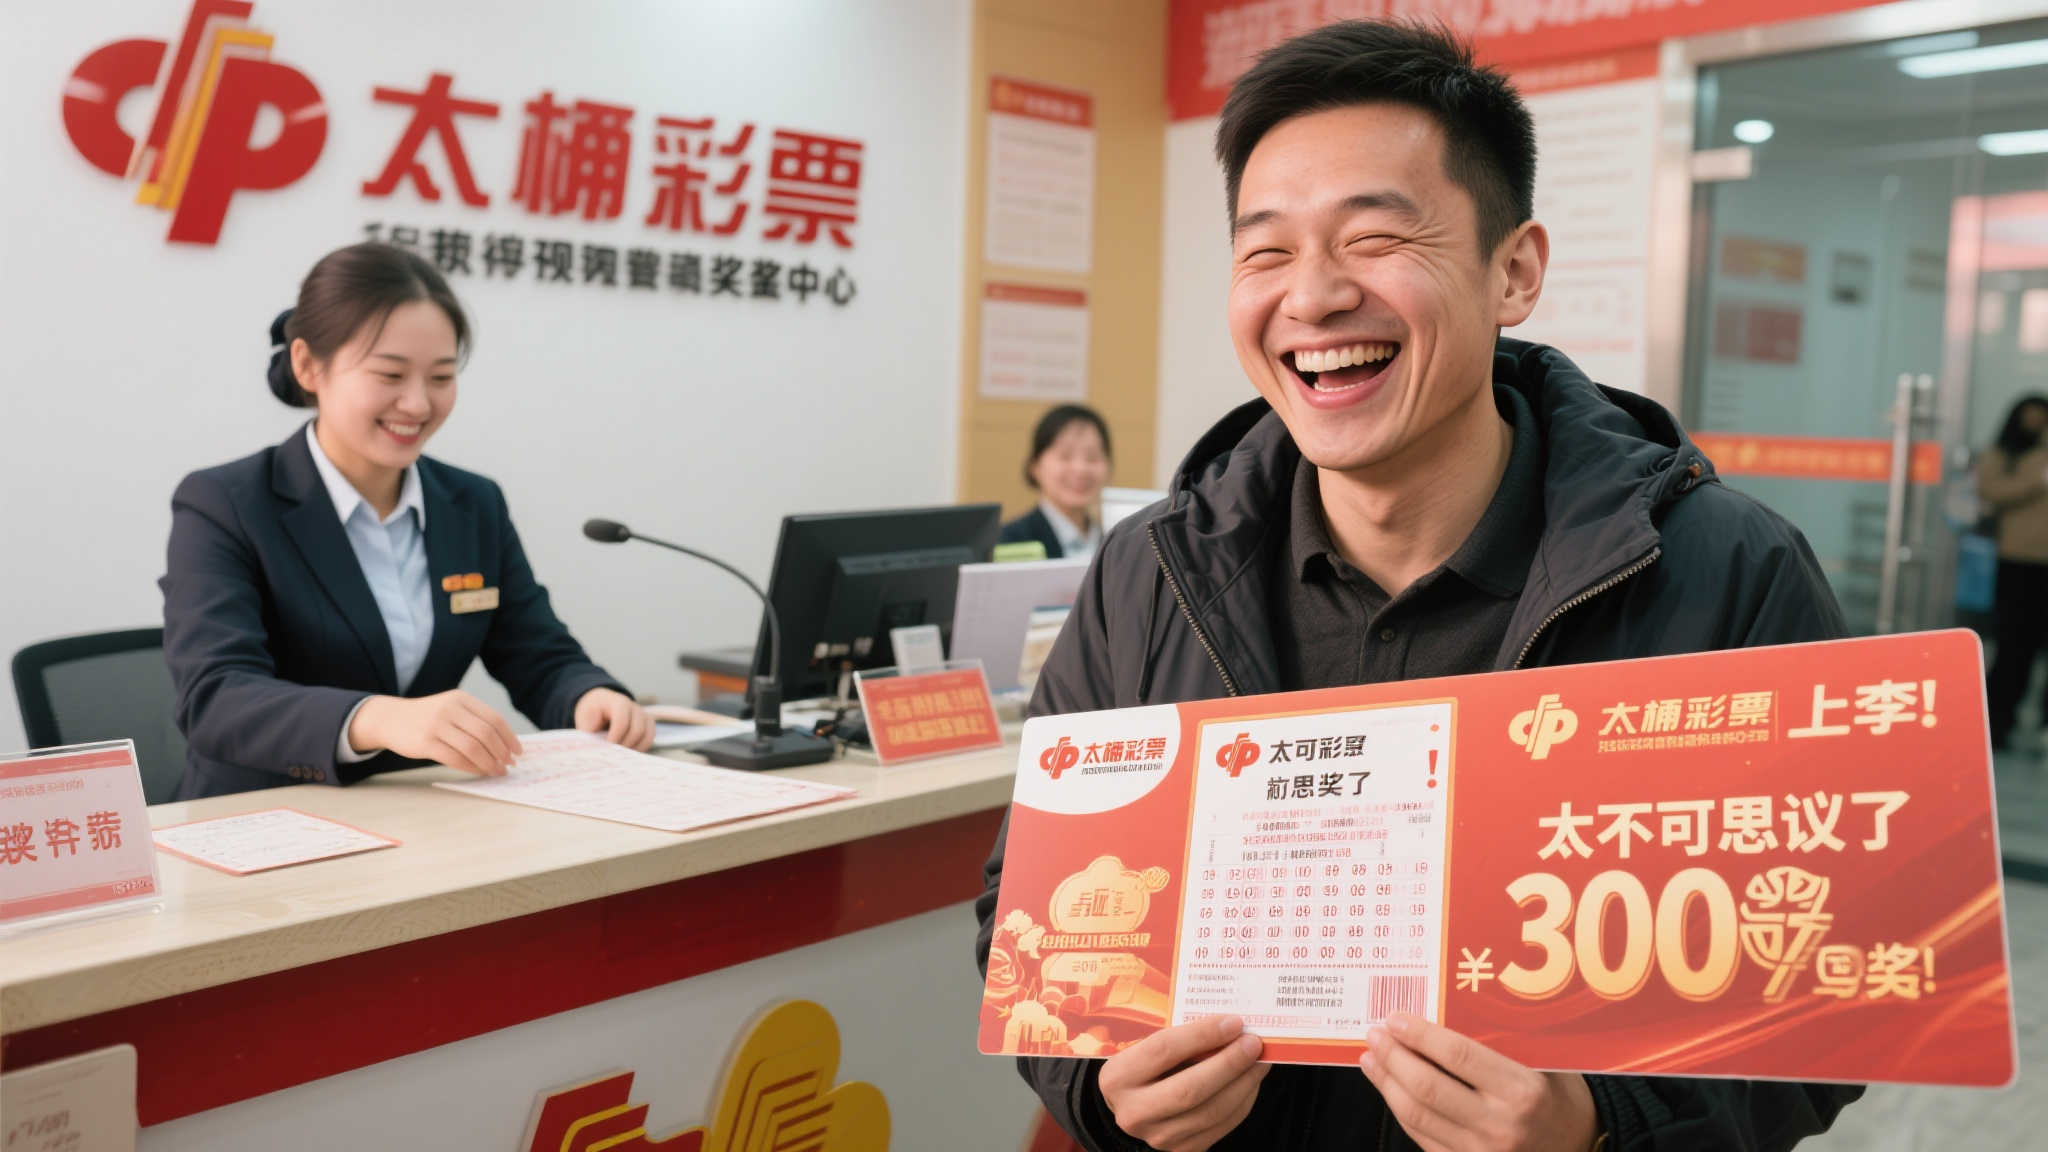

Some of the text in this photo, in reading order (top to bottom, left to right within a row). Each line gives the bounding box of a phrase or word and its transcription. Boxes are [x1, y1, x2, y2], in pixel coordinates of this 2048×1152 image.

[1536, 790, 1911, 861] 太不可思议了
